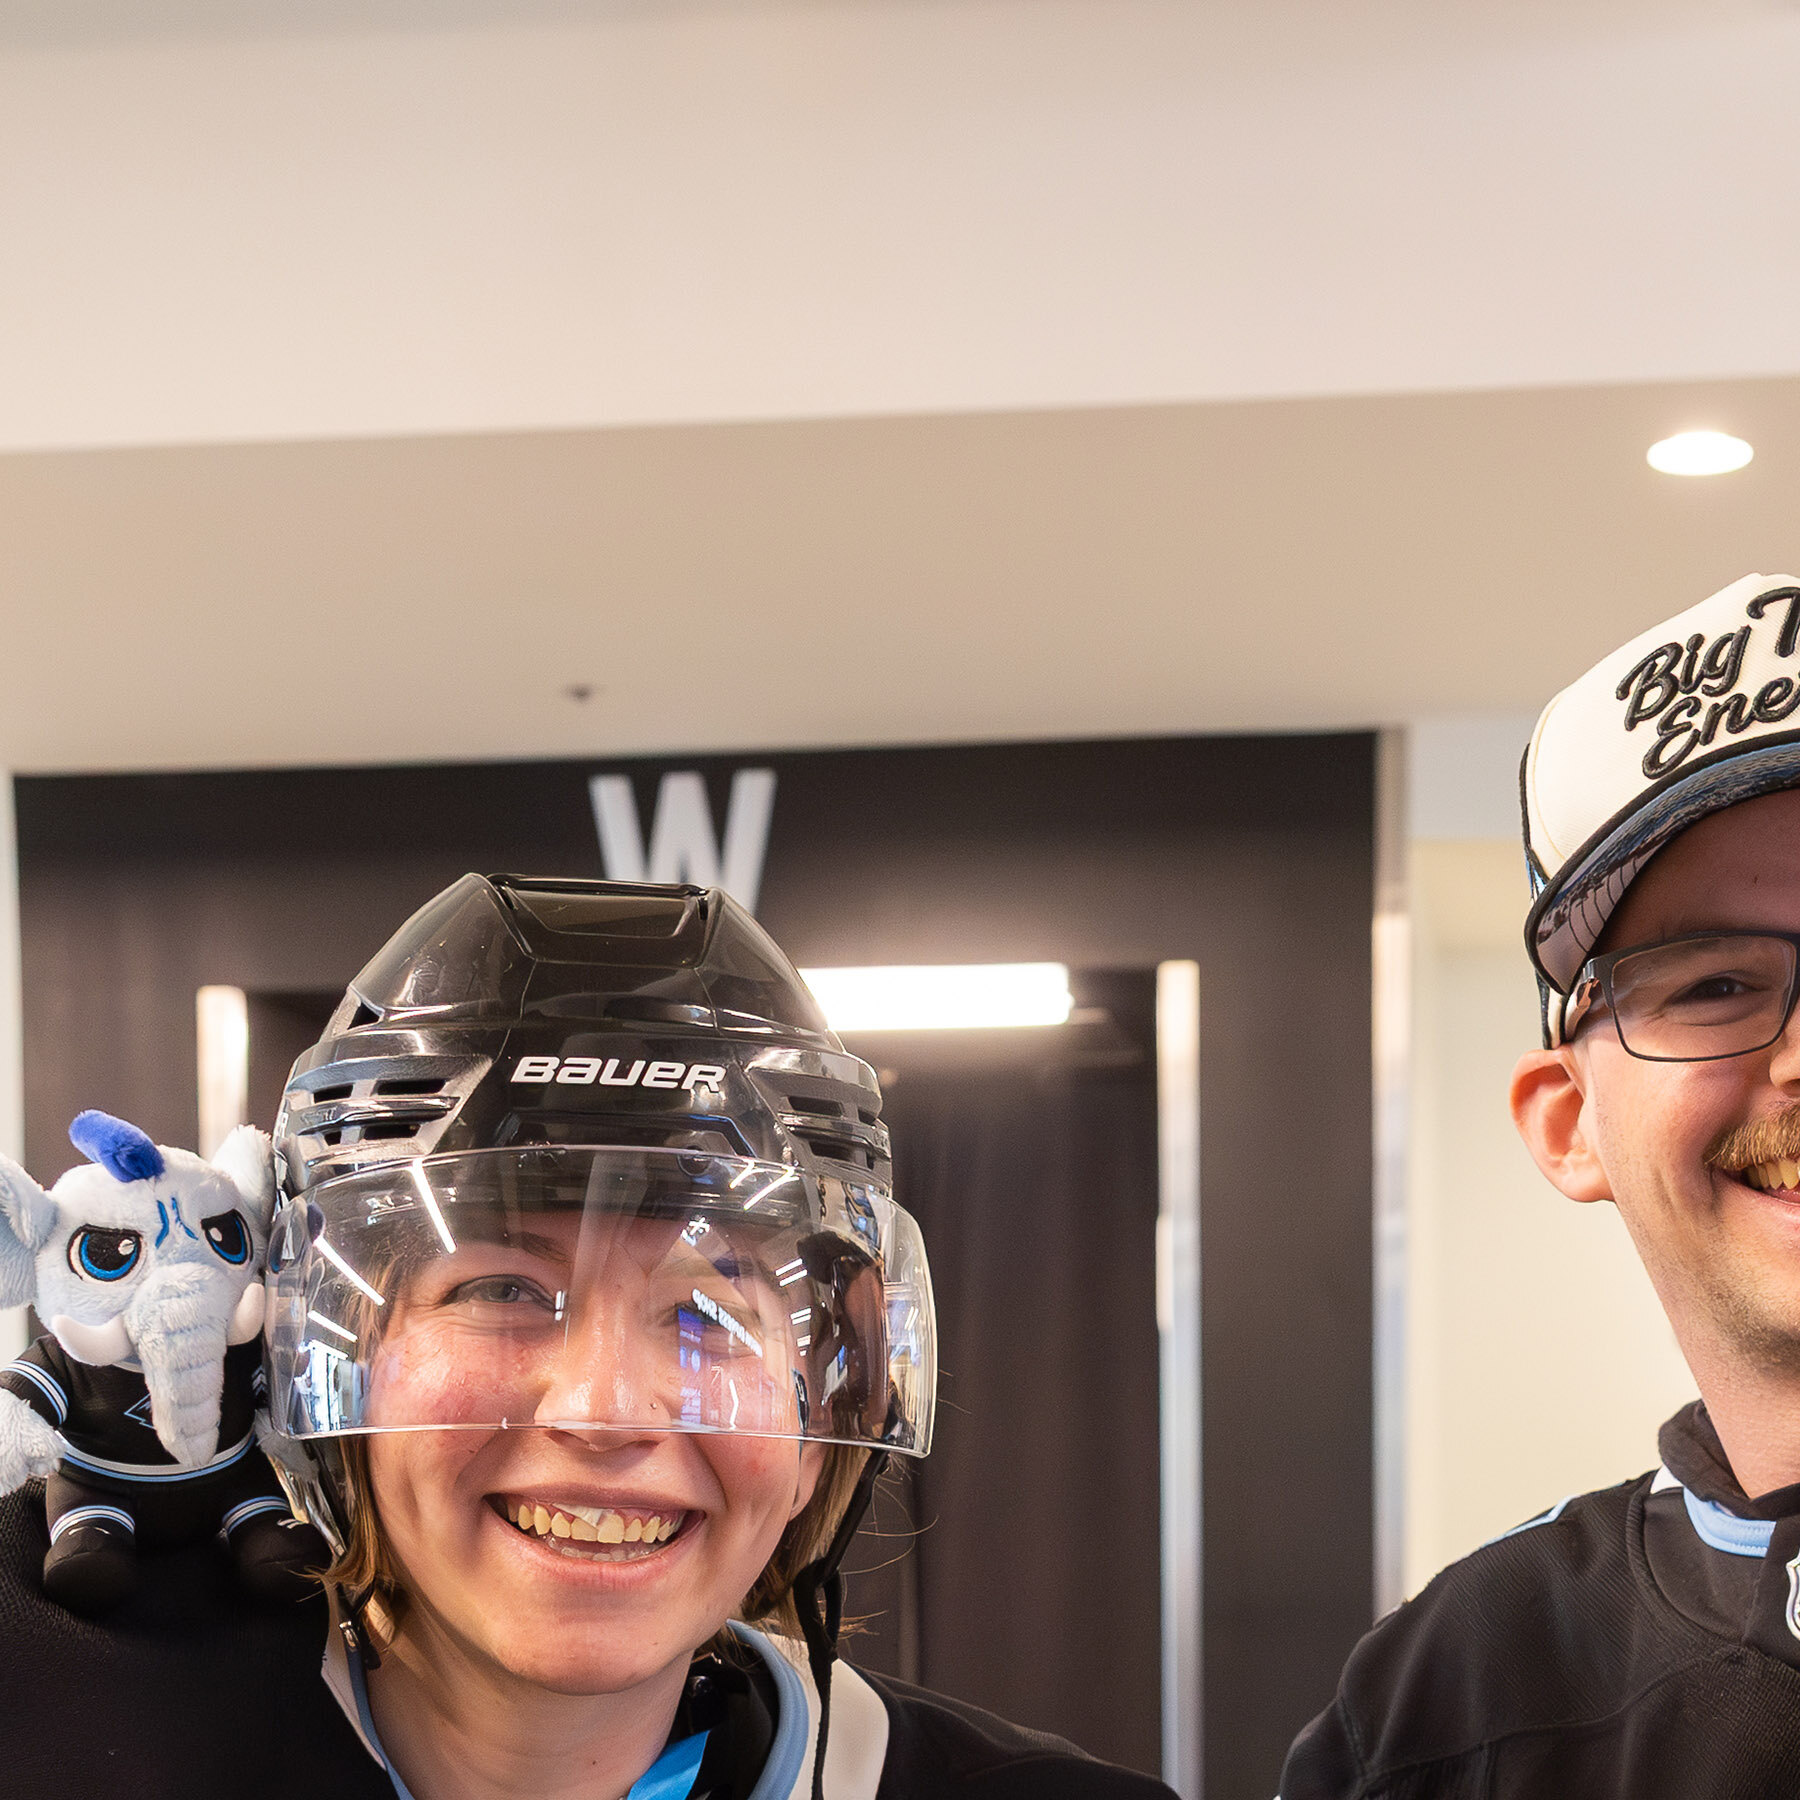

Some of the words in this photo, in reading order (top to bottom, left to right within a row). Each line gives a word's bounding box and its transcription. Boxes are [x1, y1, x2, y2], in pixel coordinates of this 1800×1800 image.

[1616, 625, 1751, 732] Big
[589, 766, 777, 918] W
[510, 1055, 727, 1092] BAUER
